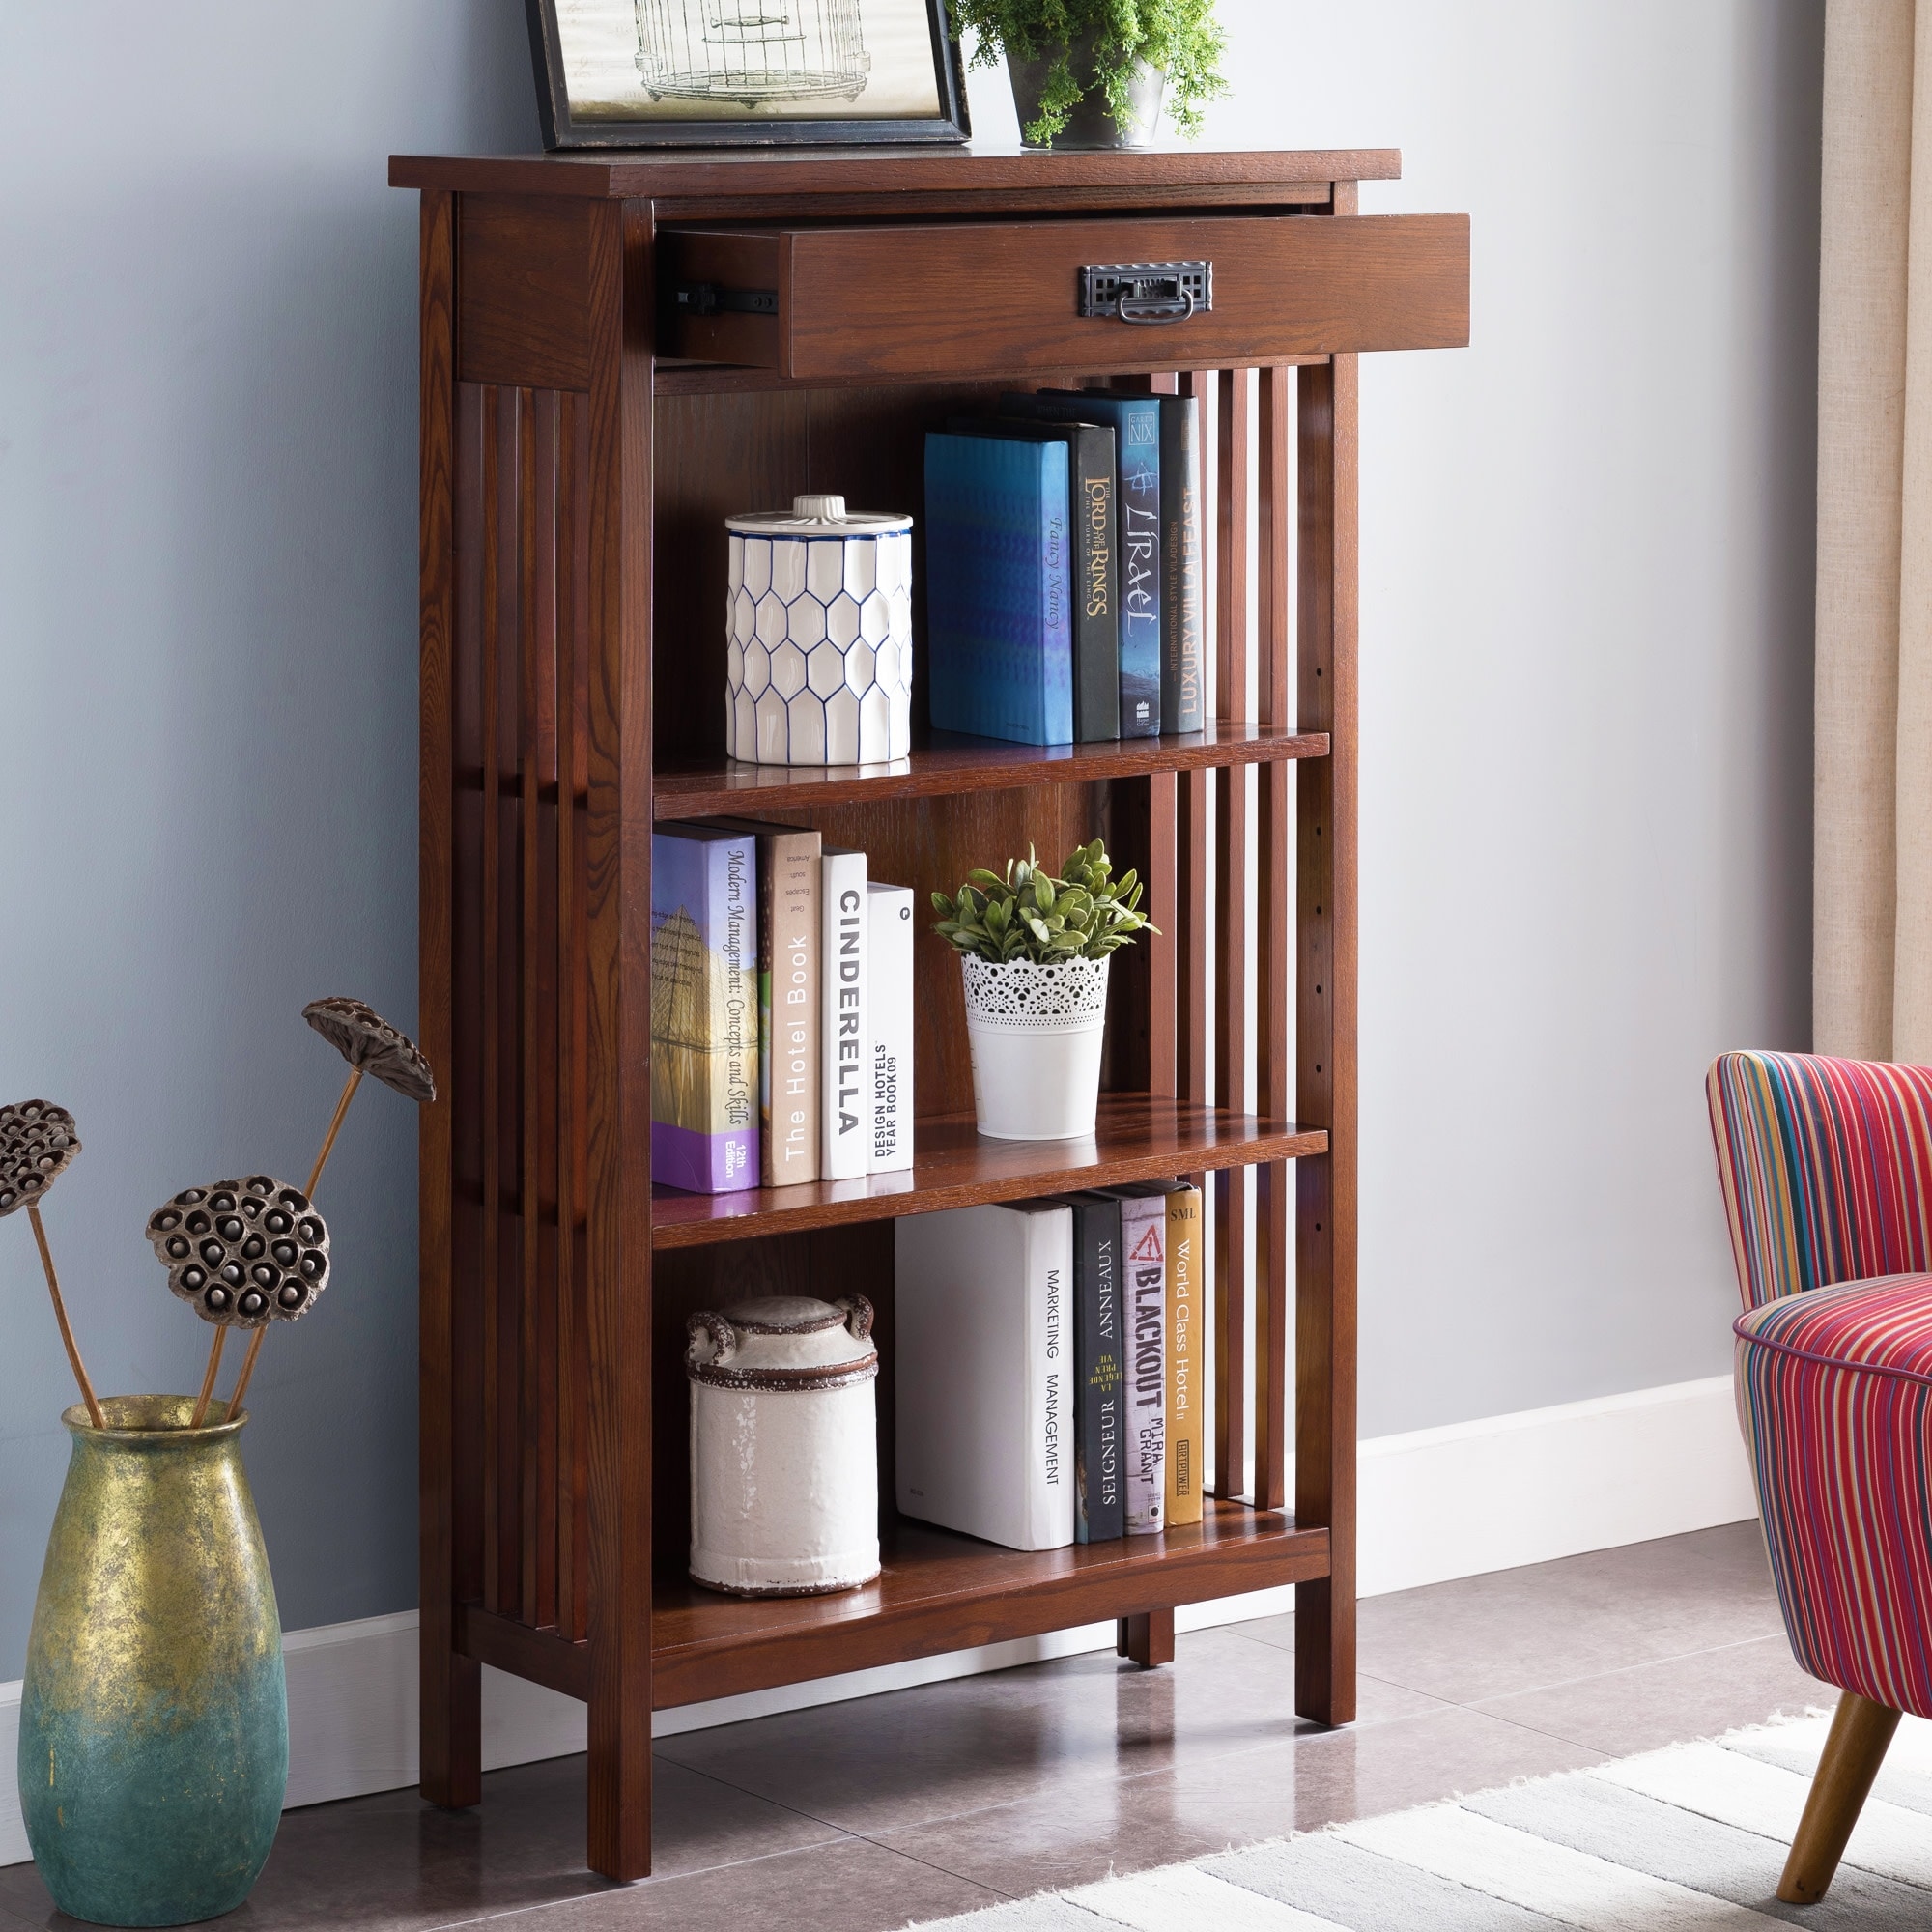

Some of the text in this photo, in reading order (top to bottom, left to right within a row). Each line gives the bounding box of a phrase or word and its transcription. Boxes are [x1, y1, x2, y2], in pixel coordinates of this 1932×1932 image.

[1130, 424, 1153, 442] NIX
[1085, 477, 1110, 530] LORD
[1098, 532, 1106, 546] OF
[1045, 517, 1063, 629] Fancy Nancy
[1086, 548, 1109, 617] RINGS
[1182, 488, 1197, 713] LUXURY VILLA FEAST
[723, 850, 749, 1125] Modern Management: Concepts and Skills
[839, 890, 860, 1136] CINDERELLA
[785, 935, 807, 1161] The Hotel Book
[875, 1044, 886, 1157] DESIGN HOTELS
[725, 1140, 736, 1178] Edition
[736, 1145, 746, 1167] 12th
[886, 1120, 896, 1157] YEAR
[1171, 1208, 1196, 1222] SML
[1176, 1238, 1190, 1299] World
[1135, 1267, 1161, 1407] BLACKOUT
[1176, 1304, 1189, 1353] Class
[1044, 1269, 1060, 1485] MARKETING MANAGEMENT
[1099, 1239, 1116, 1505] SEIGNEUR ANNEAUX
[1176, 1358, 1189, 1410] Hotel
[1140, 1429, 1154, 1484] GRANT
[1151, 1417, 1164, 1463] MIRA
[1178, 1443, 1188, 1496] ARTPOWER
